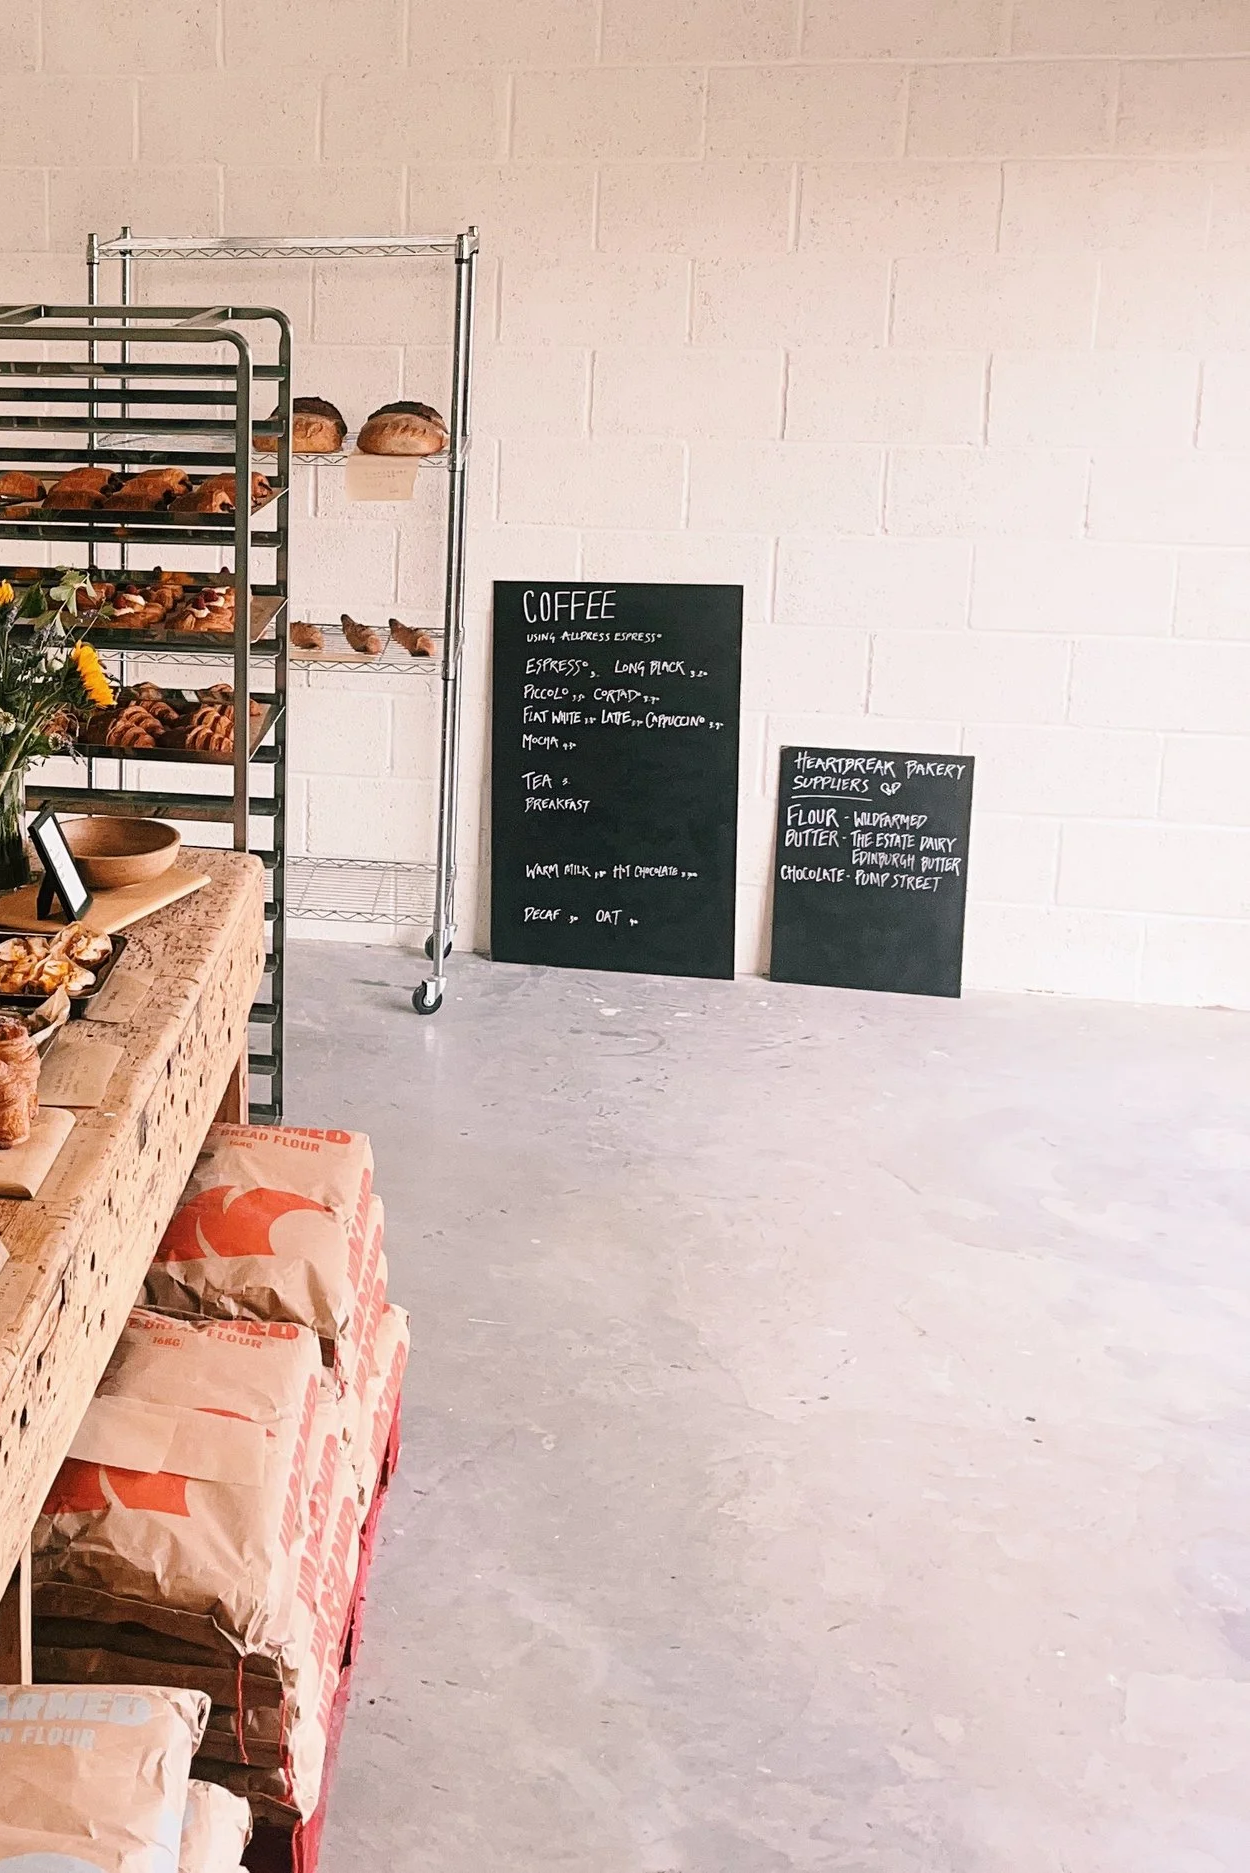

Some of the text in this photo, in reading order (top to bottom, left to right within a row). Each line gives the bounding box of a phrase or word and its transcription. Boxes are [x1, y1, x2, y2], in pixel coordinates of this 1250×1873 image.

[523, 590, 617, 623] COFFEE
[526, 630, 662, 643] USING ALLPRESS ESPRESSO
[525, 657, 589, 676] ESPRESSO
[614, 659, 645, 677] LONG
[649, 660, 686, 676] BLACK
[523, 683, 569, 700] PICCOLO
[593, 688, 641, 704] CORTADO
[523, 705, 549, 724] FLAT
[551, 711, 582, 725] WHITE
[600, 709, 632, 726] LATTE
[645, 711, 705, 729] CAPPUCCINO
[521, 733, 559, 751] MOCHA
[794, 751, 966, 780] HEARTBREAK BAKERY
[521, 771, 553, 790] TEA
[791, 775, 870, 793] SUPPLIERS
[524, 796, 591, 813] BREAKFAST
[786, 803, 840, 828] FLOUR
[853, 810, 928, 830] WILDFARMED
[784, 828, 840, 848] BUTTER
[850, 829, 874, 848] THE
[875, 832, 916, 850] ESTATE
[919, 835, 957, 853] DAIRY
[526, 863, 560, 879] WARM
[564, 863, 592, 878] MILK
[634, 865, 678, 879] CHOCOLATE
[851, 849, 962, 877] EDINBURGH BUTTER
[854, 868, 891, 888] PUMP
[890, 873, 943, 893] STREET
[523, 906, 562, 922] DECAF
[595, 909, 623, 926] OAT
[220, 1128, 268, 1141] BREAD
[272, 1135, 321, 1153] FLOUR
[152, 1336, 181, 1347] 16KG
[206, 1328, 263, 1350] FLOUR
[20, 1726, 97, 1751] FLOUR
